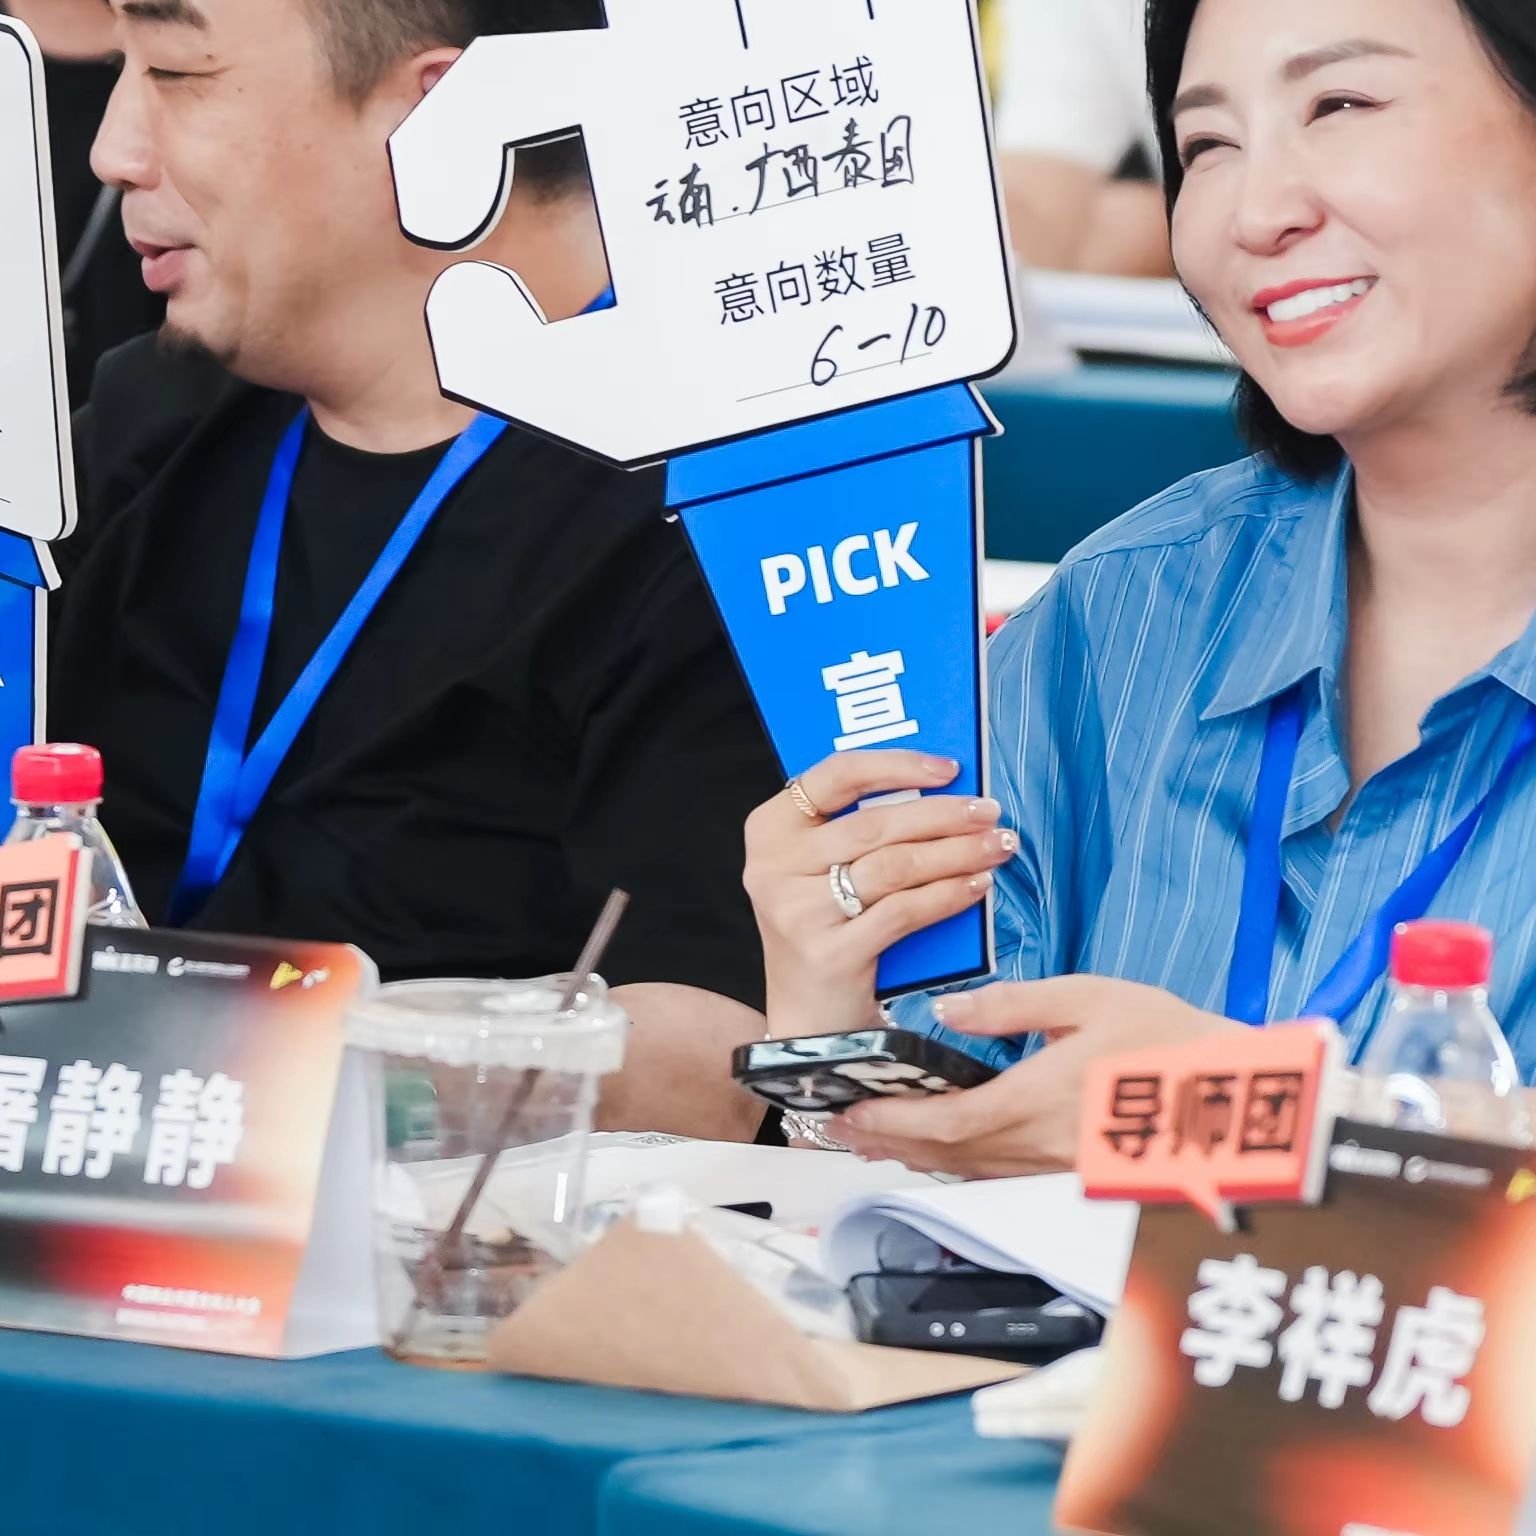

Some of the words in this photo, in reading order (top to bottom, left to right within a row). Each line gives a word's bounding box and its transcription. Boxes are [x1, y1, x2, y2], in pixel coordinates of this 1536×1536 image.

[677, 55, 880, 151] 意向区域
[714, 233, 916, 325] 意向数量
[760, 521, 930, 616] PICK
[821, 650, 921, 809] 宣
[1102, 1070, 1306, 1160] 导师团
[1179, 1252, 1487, 1429] 李祥虎
